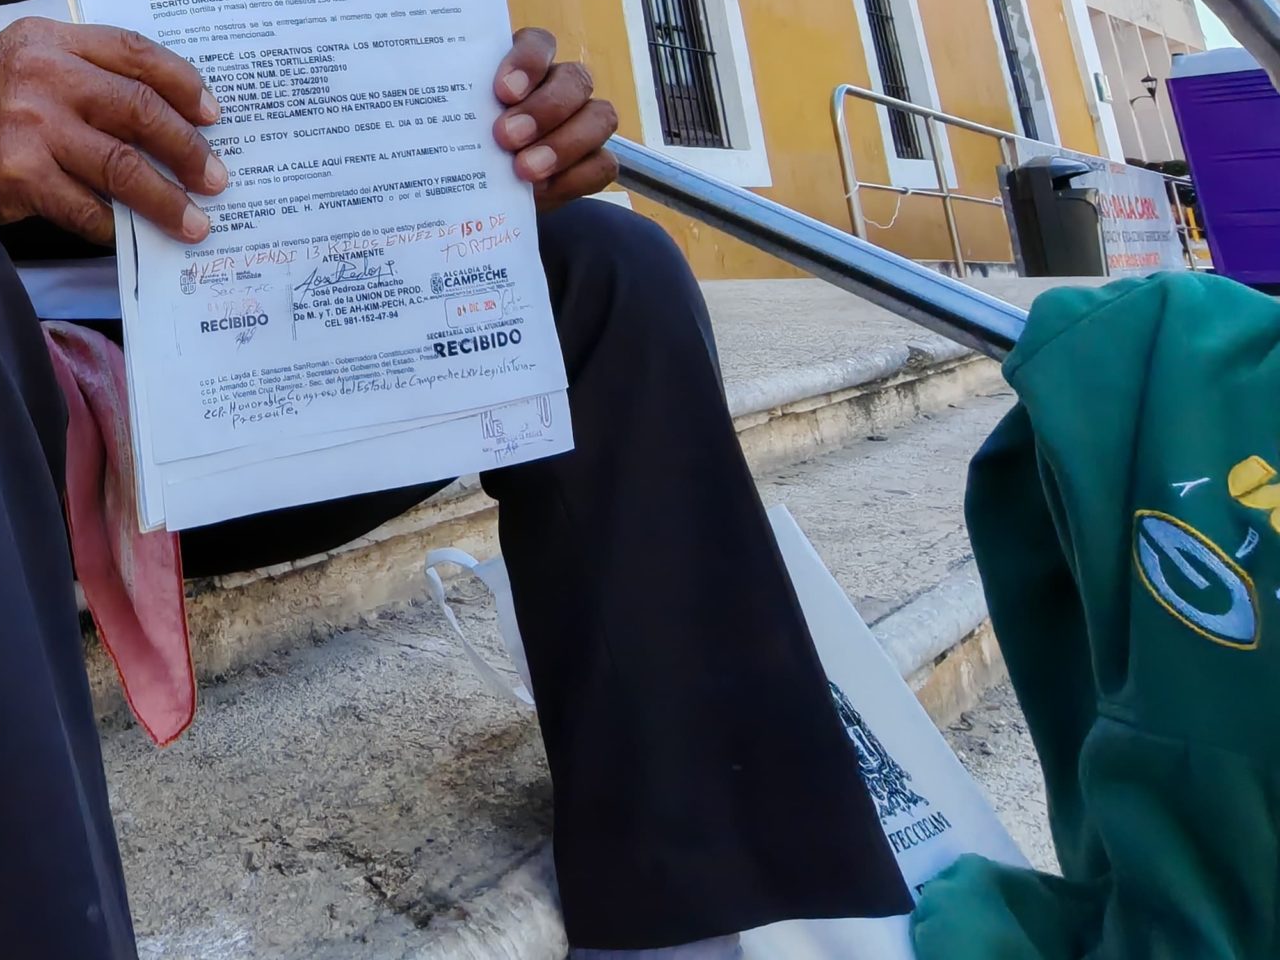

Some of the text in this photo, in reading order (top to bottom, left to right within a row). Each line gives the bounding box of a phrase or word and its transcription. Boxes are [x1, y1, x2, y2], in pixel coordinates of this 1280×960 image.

[153, 7, 188, 19] producto
[158, 24, 210, 36] Dicho escrito
[198, 35, 443, 63] EMPECÉ LOS OPERATIVOS CONTRA MOTOTORTILLEROS
[208, 63, 347, 83] MAYO CON NUM. LIC. 0370/2010
[250, 59, 273, 69] TRES
[290, 75, 328, 86] 3704/2010
[291, 85, 329, 96] 2705/2010
[220, 81, 472, 113] ENCONTRAMOS ALGUNOS QUE NO SABEN MTS. Y
[253, 94, 448, 121] EL REGLAMENTO HA ENTRADO EN FUNCIONES.
[208, 111, 476, 147] SCRITO LO ESTOY SOLICITANDO DESDE DIA JULIO DEL
[223, 144, 244, 156] AÑO.
[238, 145, 448, 176] CERRAR CALLE AQUÍ FRENTE AL AYUNTAMIENTO
[219, 182, 475, 221] SECRETARIO H. AYUNTAMIENTO SUBDIRECTOR
[230, 220, 258, 231] MPAL.
[461, 221, 483, 238] 150
[322, 248, 384, 262] ATENTAMENTE
[310, 277, 403, 297] José Pedroza Camacho
[444, 268, 508, 287] CAMPECHE
[292, 300, 310, 310] Sec.
[312, 297, 332, 308] Gral.
[355, 290, 382, 302] UNION
[397, 285, 423, 296] PROD.
[293, 297, 407, 321] De M. T. AH-KIM-PECH,
[324, 310, 398, 328] CEL 981-152-47-94
[201, 313, 268, 333] RECIBIDO
[434, 329, 522, 358] RECIBIDO
